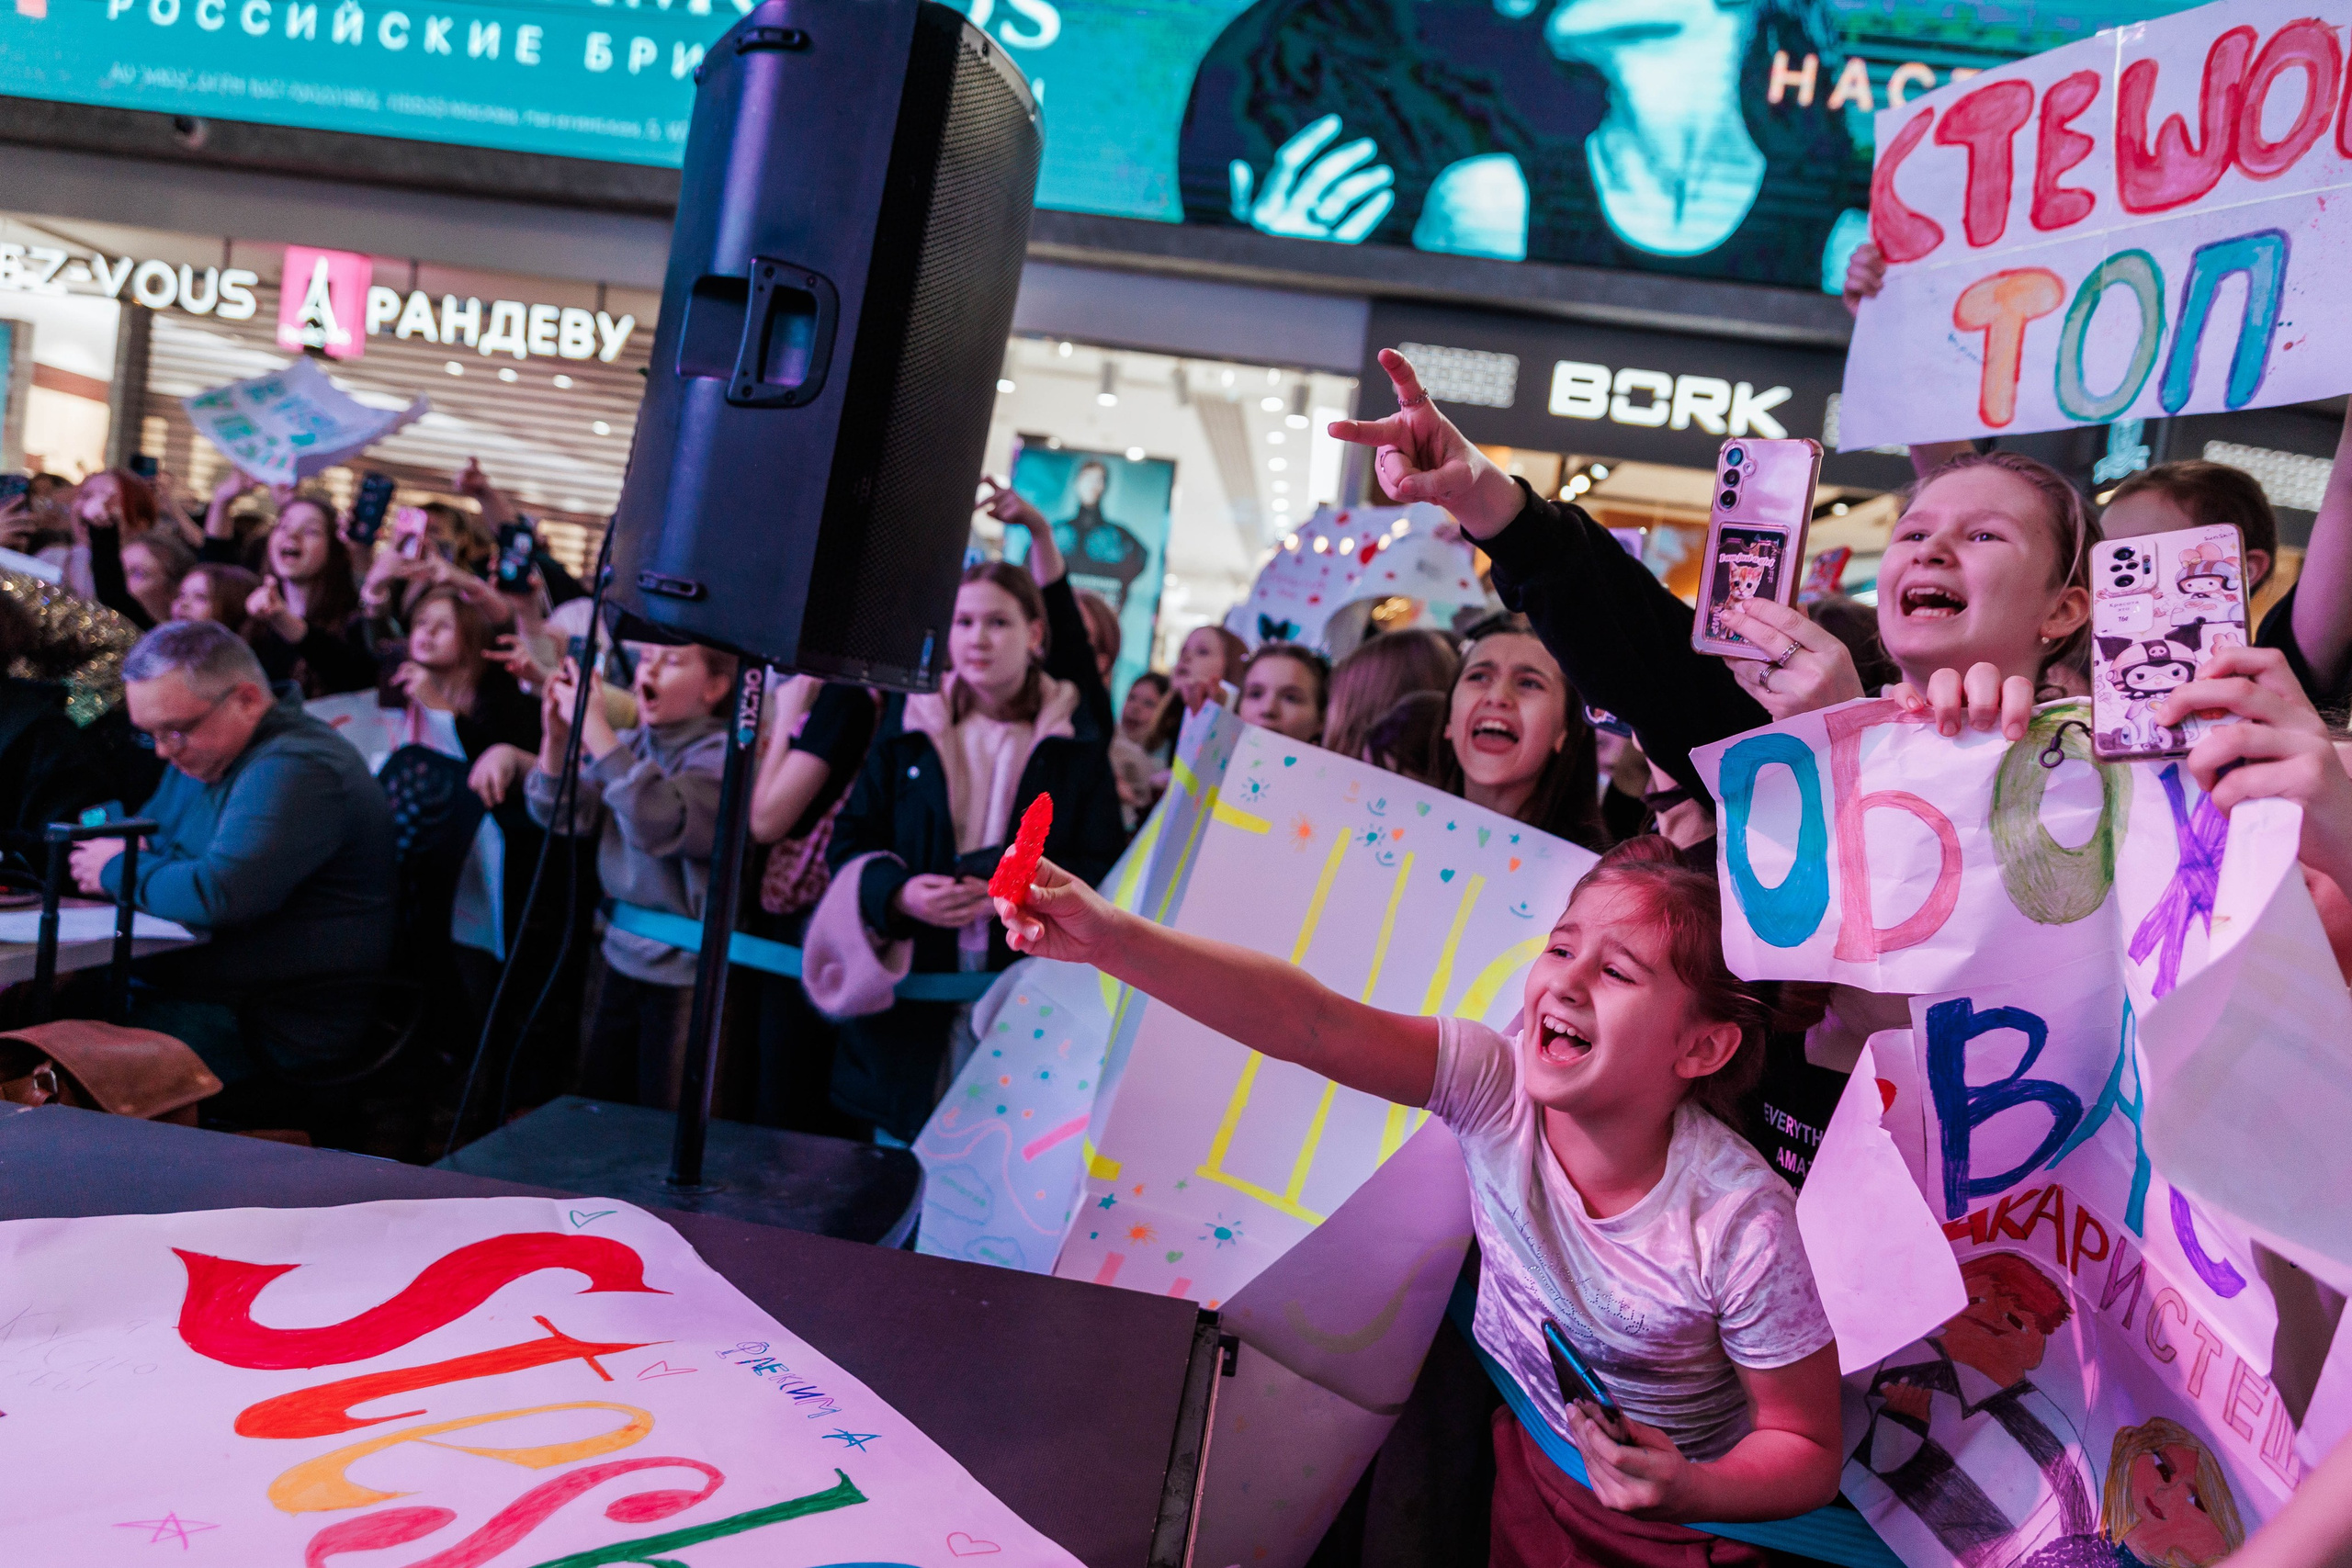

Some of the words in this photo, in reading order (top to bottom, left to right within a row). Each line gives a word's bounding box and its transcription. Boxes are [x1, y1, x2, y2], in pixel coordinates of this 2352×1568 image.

[106, 0, 543, 65] РОССИЙСКИЕ
[1767, 50, 1984, 111] НАС
[365, 286, 636, 363] РАНДЕВУ
[1953, 227, 2292, 428] ТОП
[1548, 359, 1792, 439] BORK
[1776, 1146, 1813, 1178] AMA
